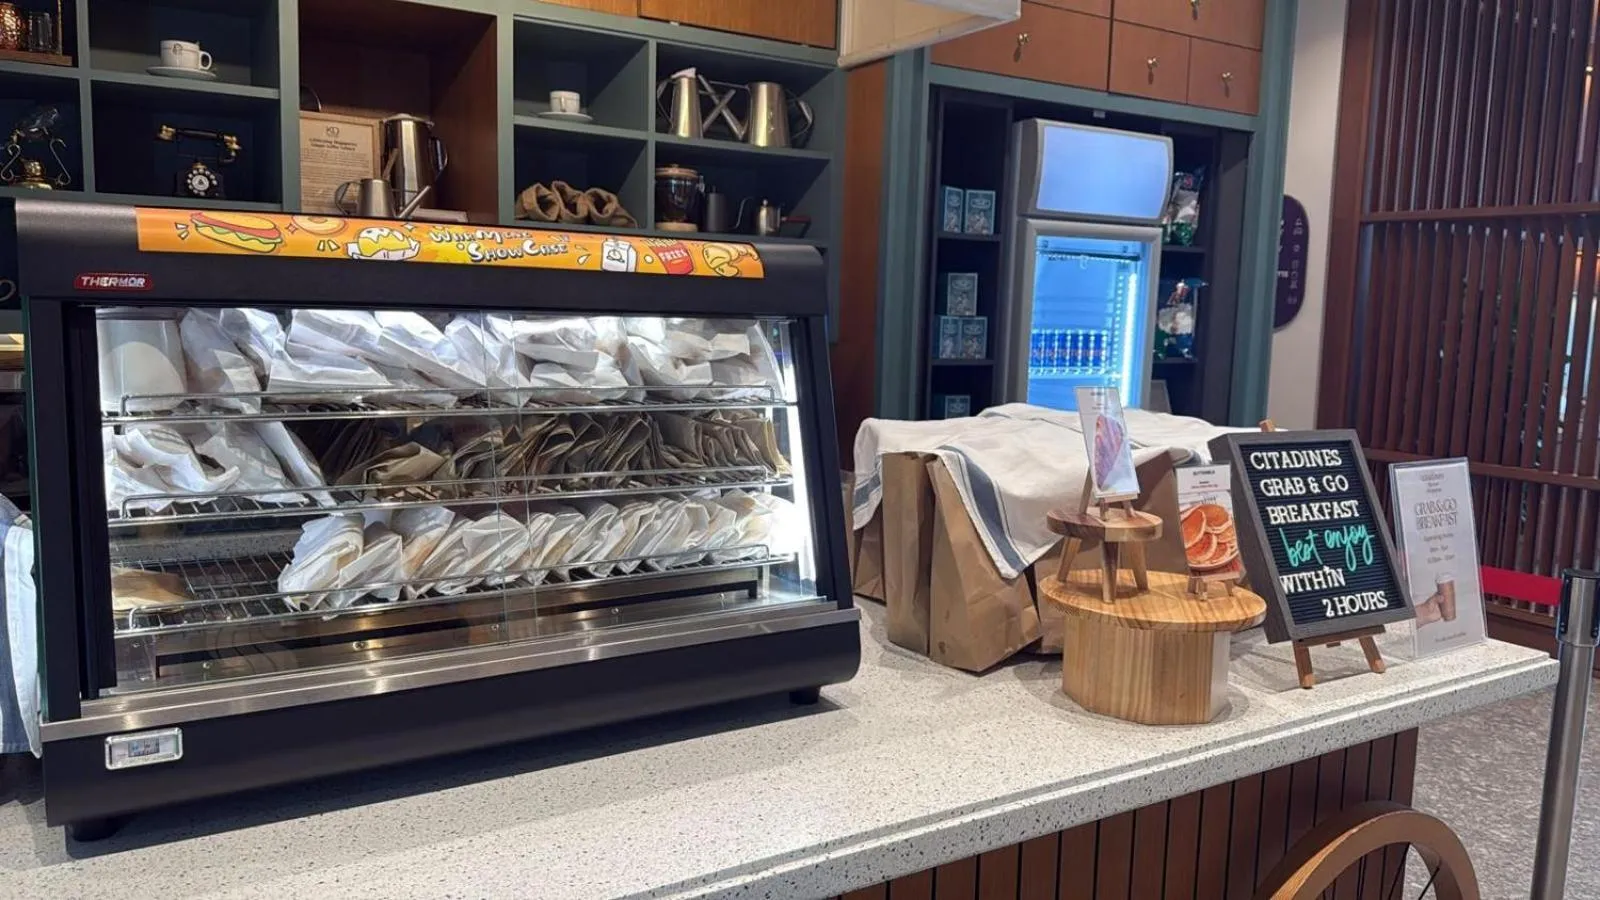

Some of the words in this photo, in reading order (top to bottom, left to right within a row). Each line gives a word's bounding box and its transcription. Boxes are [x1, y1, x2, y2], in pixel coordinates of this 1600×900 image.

[80, 276, 146, 288] THERMOR
[1250, 449, 1342, 469] CITADINES
[1260, 476, 1306, 497] GRAB
[1309, 476, 1321, 494] &
[1322, 474, 1349, 492] GO
[1266, 500, 1360, 525] BREAKFAST
[1278, 527, 1324, 567] best
[1324, 524, 1375, 572] enjoy
[1322, 599, 1335, 618] 2
[1336, 590, 1388, 616] HOURS
